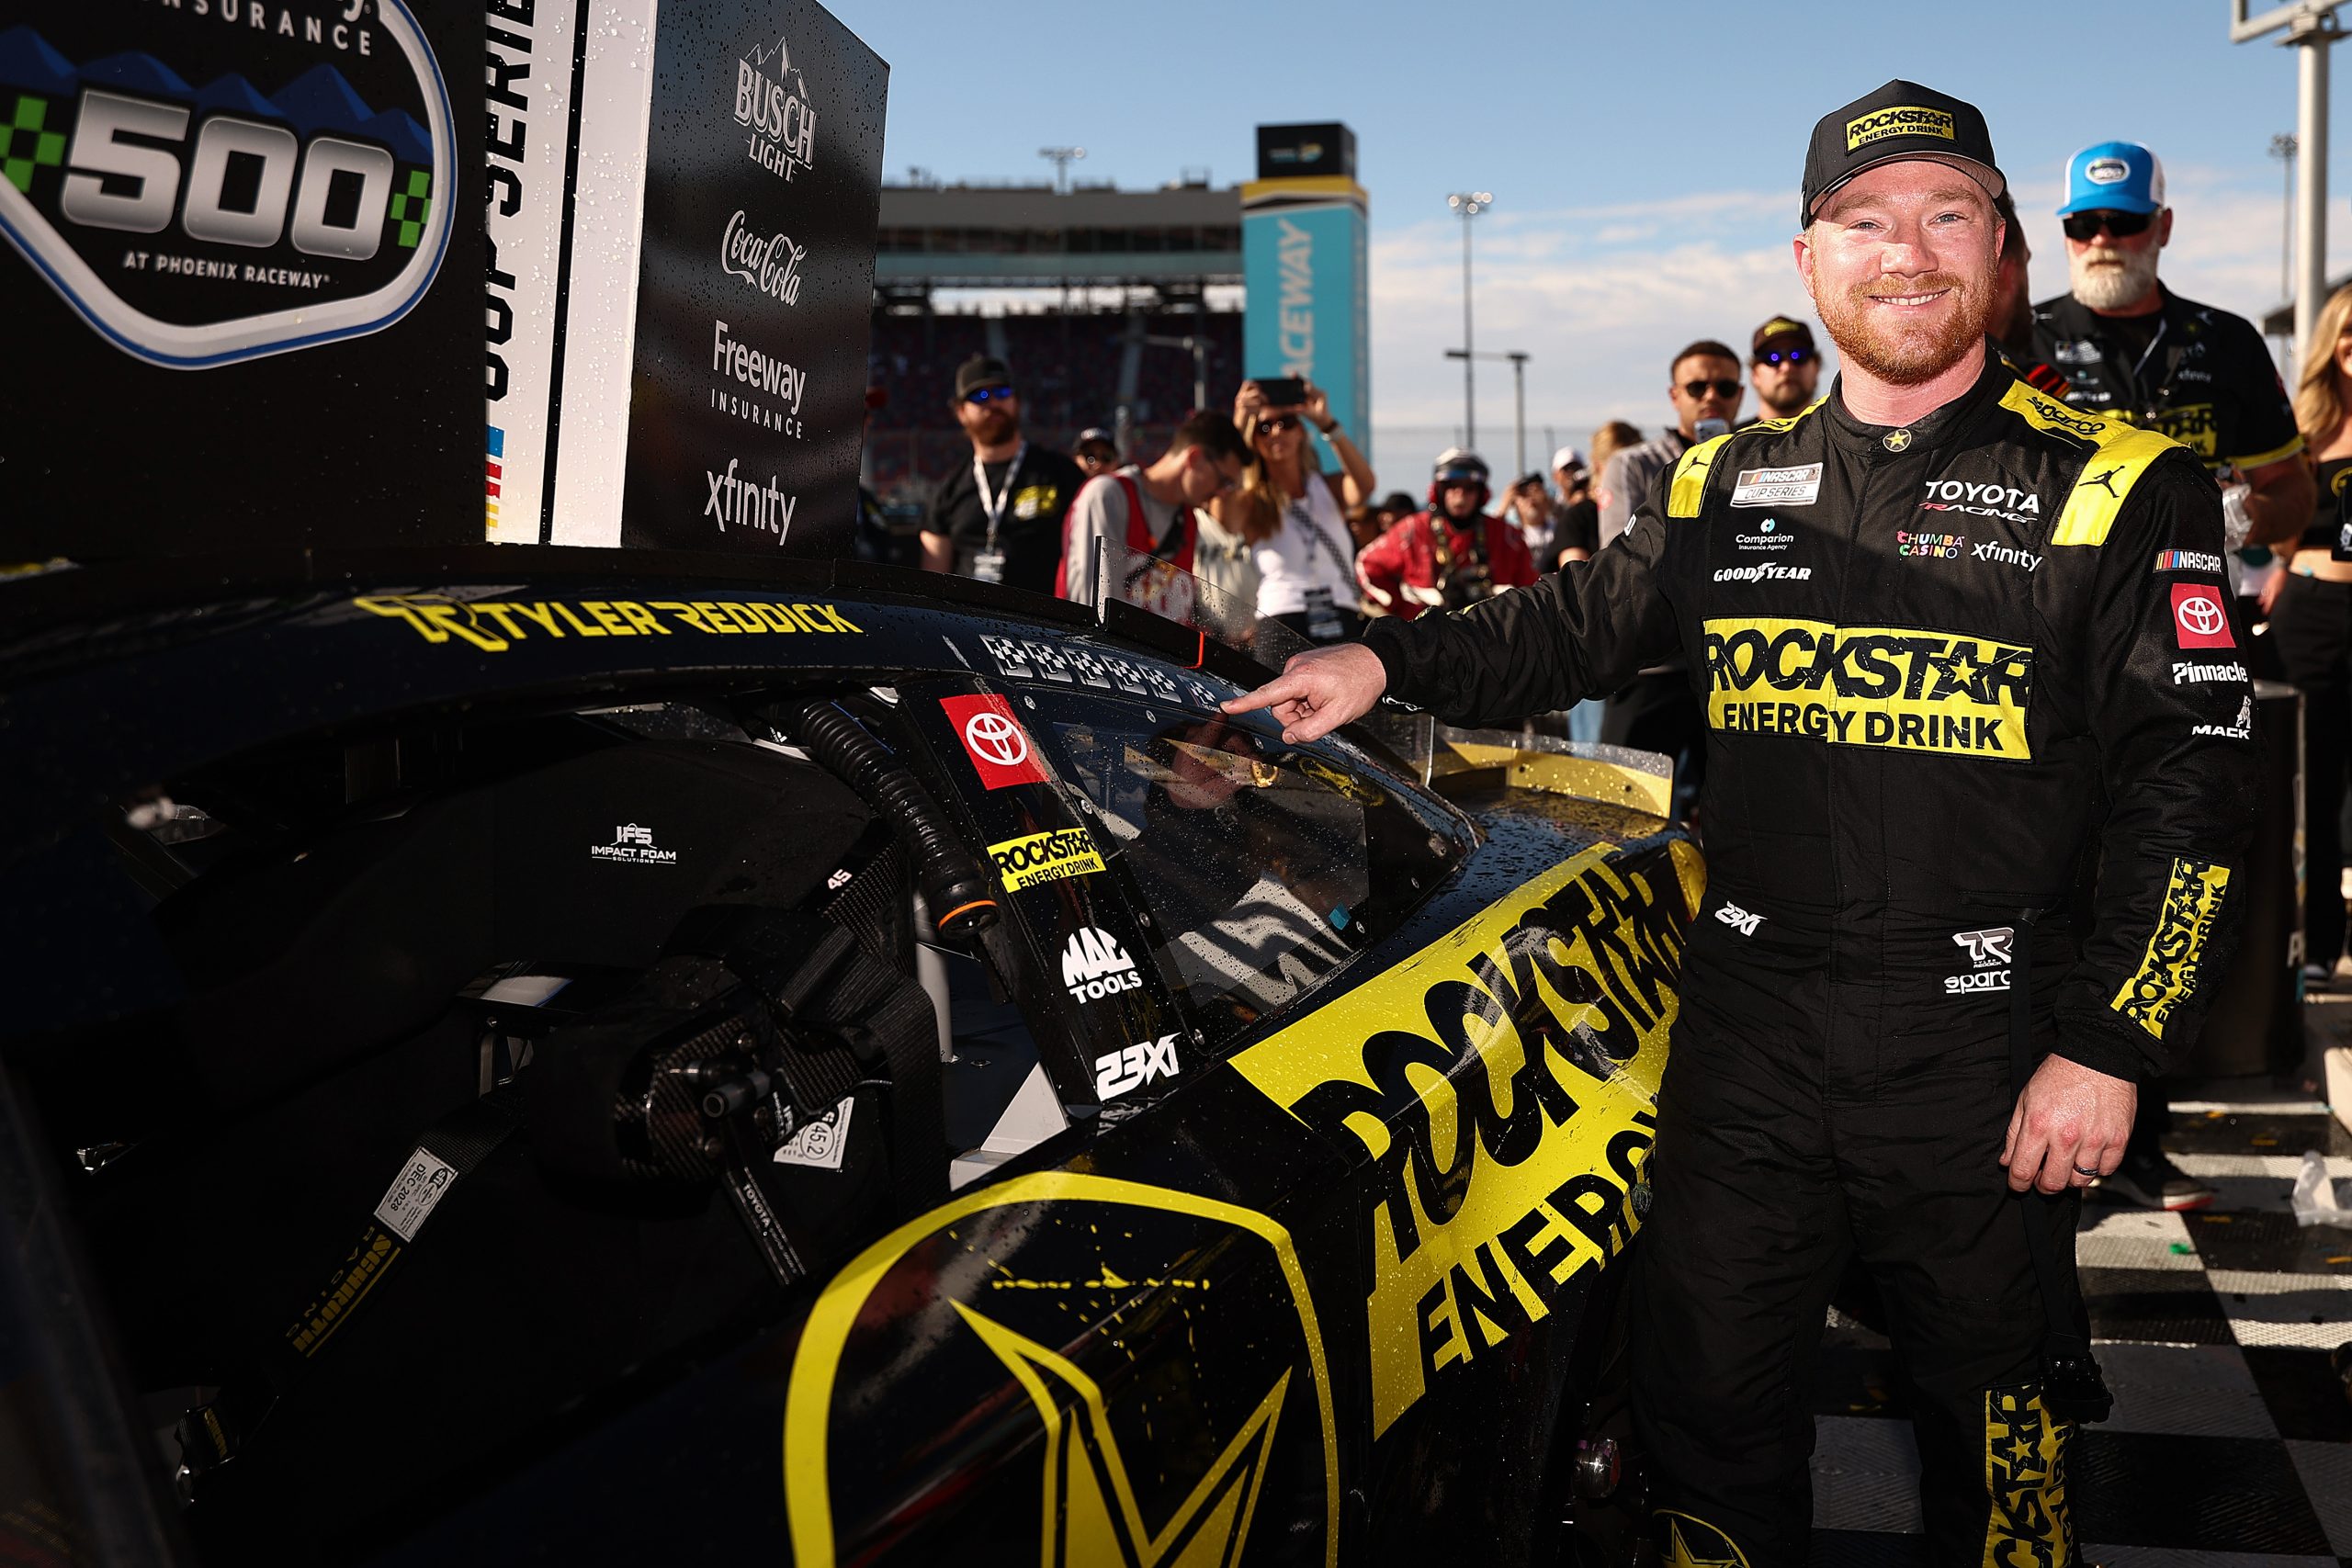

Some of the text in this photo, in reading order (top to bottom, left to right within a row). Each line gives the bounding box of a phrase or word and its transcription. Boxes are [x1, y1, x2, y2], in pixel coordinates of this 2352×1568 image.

[143, 0, 371, 56] SURANCE
[486, 0, 535, 218] SERIE
[733, 58, 817, 170] BUSCH
[1849, 109, 1952, 140] ROCKSTAR
[1859, 125, 1944, 144] ENERGY DRINK
[61, 89, 394, 261] 500
[748, 133, 797, 184] LIGHT
[124, 250, 323, 289] AT PHOENIX RACEWAY
[1276, 217, 1314, 379] ACEWAY
[713, 320, 807, 415] Freeway
[711, 388, 803, 439] INSURANCE
[2026, 396, 2106, 436] sparco
[1745, 485, 1807, 500] CUP SERIES
[1763, 468, 1810, 483] NASCAR
[704, 457, 797, 547] xfinity
[1917, 502, 2039, 524] RACING
[1925, 479, 2041, 514] TOYOTA
[1735, 533, 1794, 546] Comparion
[1896, 530, 1964, 548] CHUMBA
[1898, 544, 1959, 559] CASINO
[1970, 540, 2043, 572] xfinity
[2178, 550, 2222, 573] NASCAR
[472, 601, 673, 639] TYLER
[646, 601, 865, 634] REDDICK
[1704, 628, 2032, 708] ROCKSTAR
[2171, 660, 2249, 685] Pinnacle
[1723, 702, 2005, 752] ENERGY DRINK
[2191, 724, 2251, 740] MACK
[591, 845, 677, 861] IMPACT FOAM
[612, 856, 655, 864] SOLUTIONS
[992, 829, 1098, 878] ROCKSTAR
[827, 869, 853, 891] 45
[1016, 857, 1099, 887] ENERGY DRINK
[1062, 926, 1136, 987] MAC
[2120, 857, 2205, 1028] ROCKSTAR
[1069, 969, 1143, 1005] TOOLS
[1944, 970, 2011, 994] sparc
[1286, 852, 1685, 1265] ROCKSTAR
[806, 1123, 828, 1157] 45.2
[406, 1163, 427, 1188] DEC
[390, 1186, 411, 1212] 2028
[742, 1183, 772, 1228] TOYOTA
[1416, 1095, 1657, 1385] ENERG
[1991, 1382, 2054, 1568] CKSTAR
